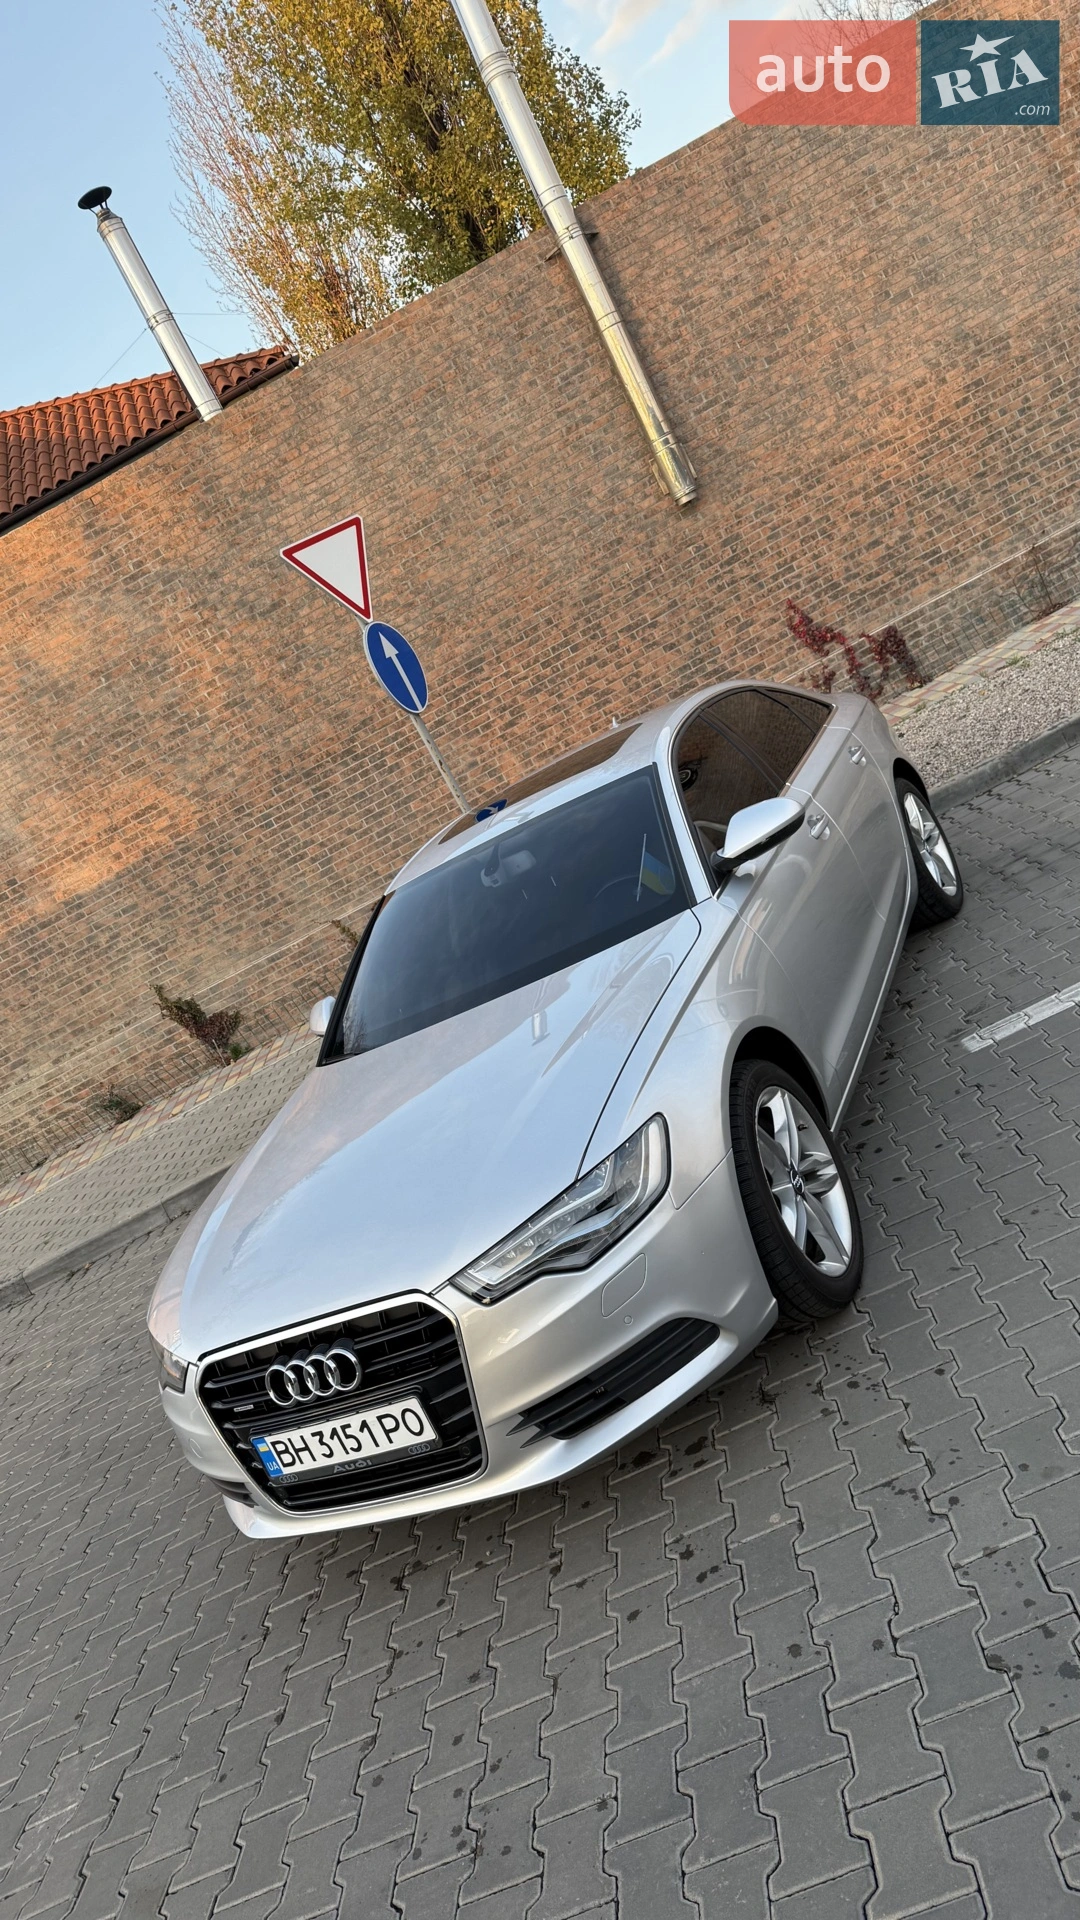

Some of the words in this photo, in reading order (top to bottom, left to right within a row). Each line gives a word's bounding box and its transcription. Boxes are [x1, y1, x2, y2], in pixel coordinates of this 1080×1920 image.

[270, 1435, 317, 1468] BH
[310, 1419, 380, 1459] 3151
[267, 1462, 280, 1471] UA
[333, 1459, 373, 1473] Audi
